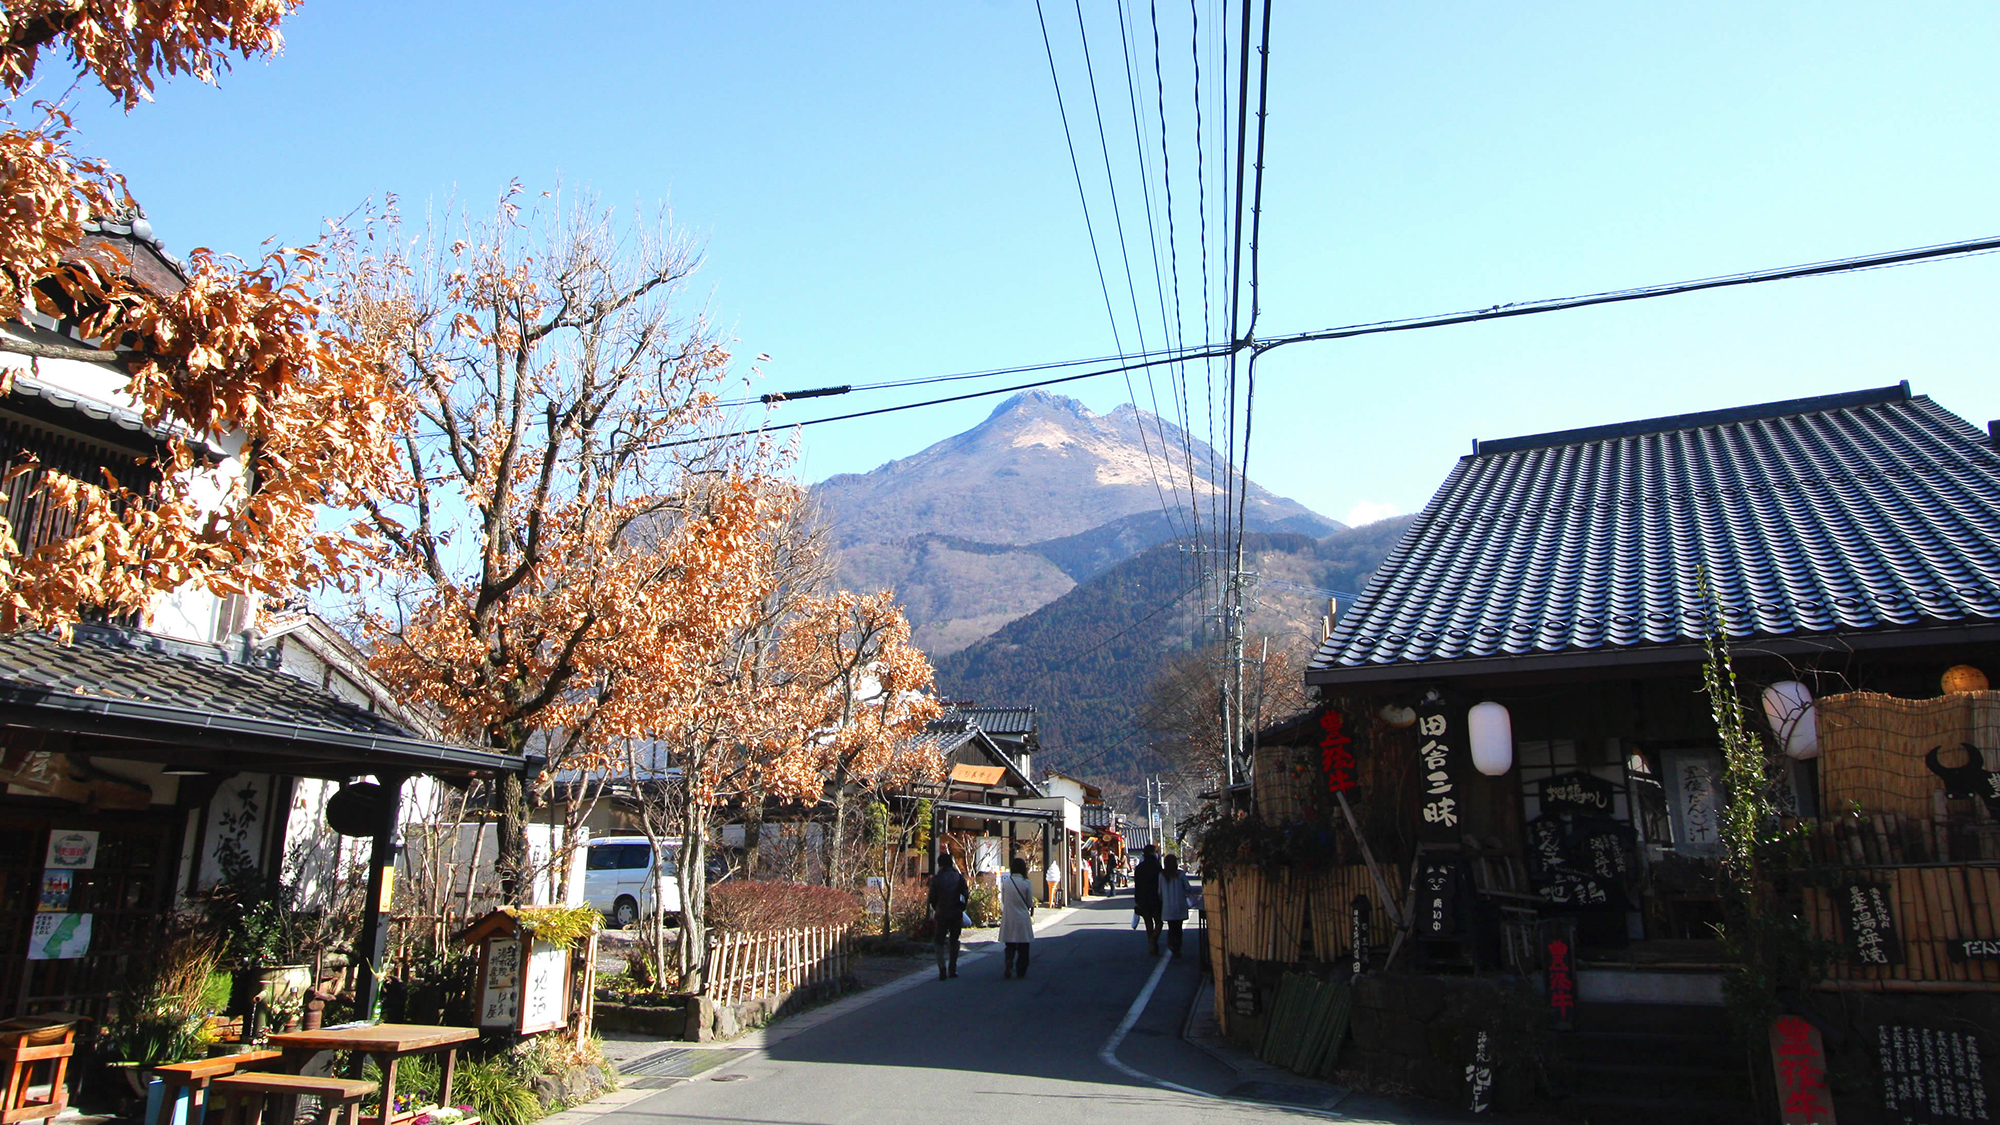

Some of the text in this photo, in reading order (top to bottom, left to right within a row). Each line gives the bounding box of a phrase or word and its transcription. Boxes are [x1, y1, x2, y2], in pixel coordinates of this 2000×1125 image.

[1319, 709, 1356, 795] 豊後牛
[1419, 713, 1458, 828] 田舎三昧
[1547, 783, 1607, 809] 地鶏めし
[1683, 764, 1710, 842] 豊後だんご汁
[1539, 881, 1607, 905] 地鶏
[1547, 939, 1574, 1019] 豊後牛
[1776, 1017, 1830, 1124] 豊後牛
